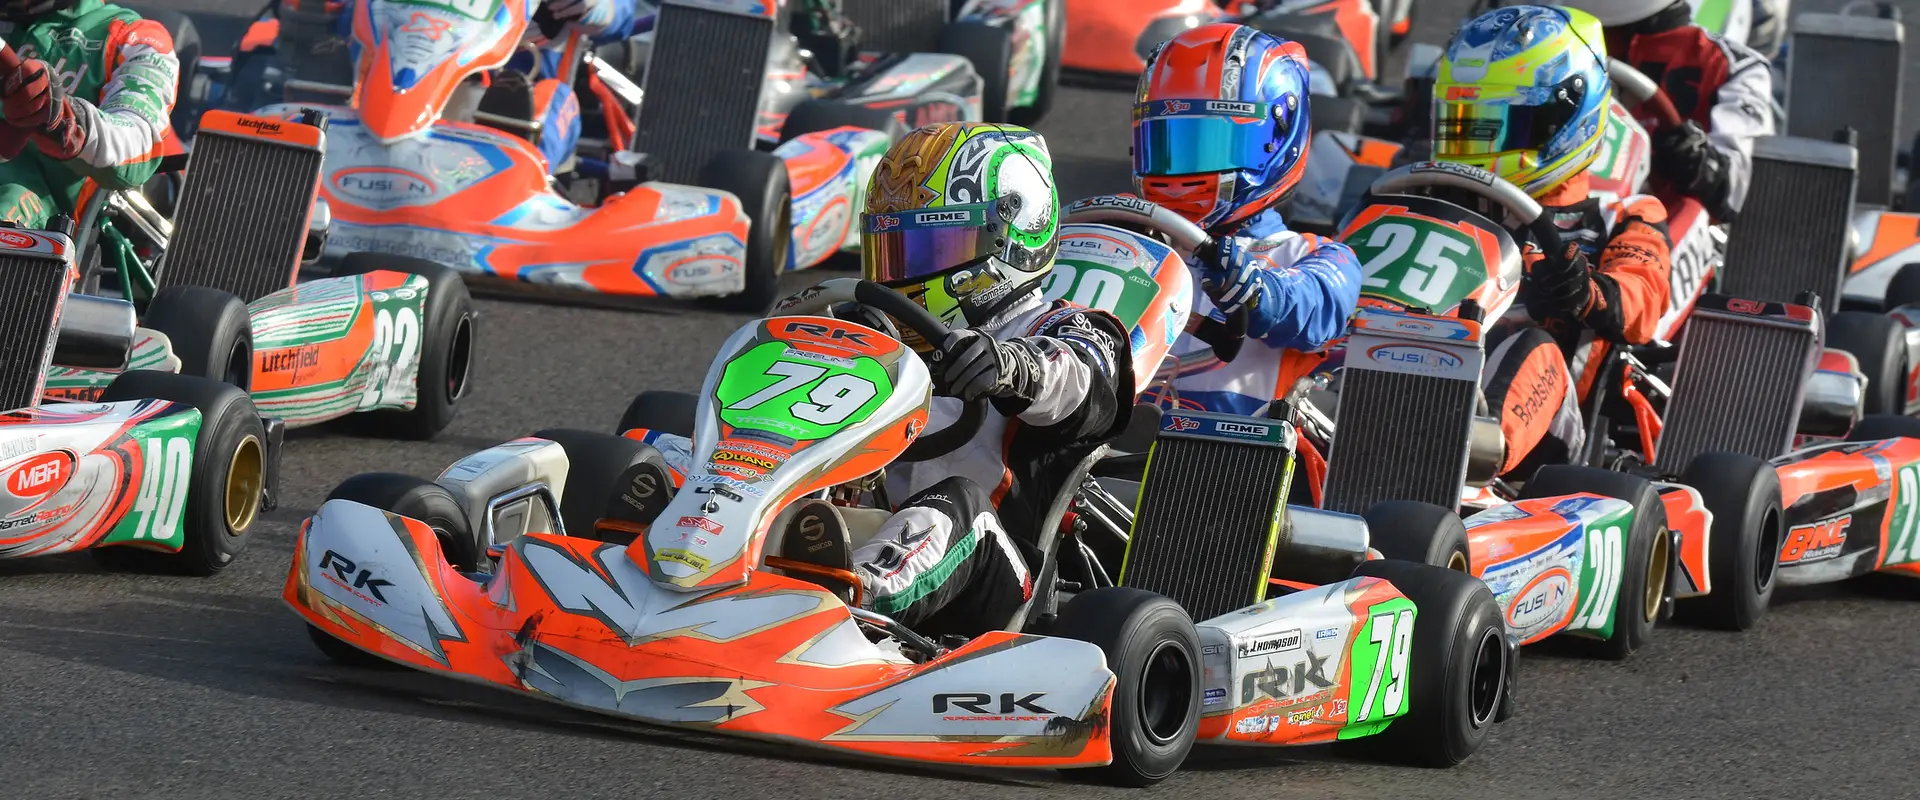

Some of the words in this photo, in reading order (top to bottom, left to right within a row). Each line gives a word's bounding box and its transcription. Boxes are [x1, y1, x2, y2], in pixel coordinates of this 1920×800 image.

[237, 117, 281, 134] Litchfield
[1161, 100, 1190, 115] X30
[1211, 102, 1252, 112] IAME
[1415, 161, 1493, 184] EXPRIT
[1072, 196, 1153, 211] EXPRIT
[874, 215, 899, 232] X30
[921, 212, 966, 222] IAME
[1362, 223, 1471, 306] 25
[784, 321, 879, 350] RK
[262, 345, 320, 385] Litchfield
[358, 307, 419, 407] 22
[724, 360, 878, 425] 79
[1512, 364, 1558, 427] Bradshaw
[1164, 417, 1201, 431] X30
[1220, 424, 1264, 434] IAME
[17, 459, 61, 491] MBR
[713, 451, 774, 469] ALFANO
[133, 437, 191, 539] 40
[1779, 514, 1852, 563] BKC
[319, 549, 396, 604] RK
[1567, 526, 1622, 630] 20
[1241, 650, 1337, 706] RK
[1356, 608, 1414, 722] 79
[932, 692, 1057, 714] RK
[1329, 699, 1348, 718] X30
